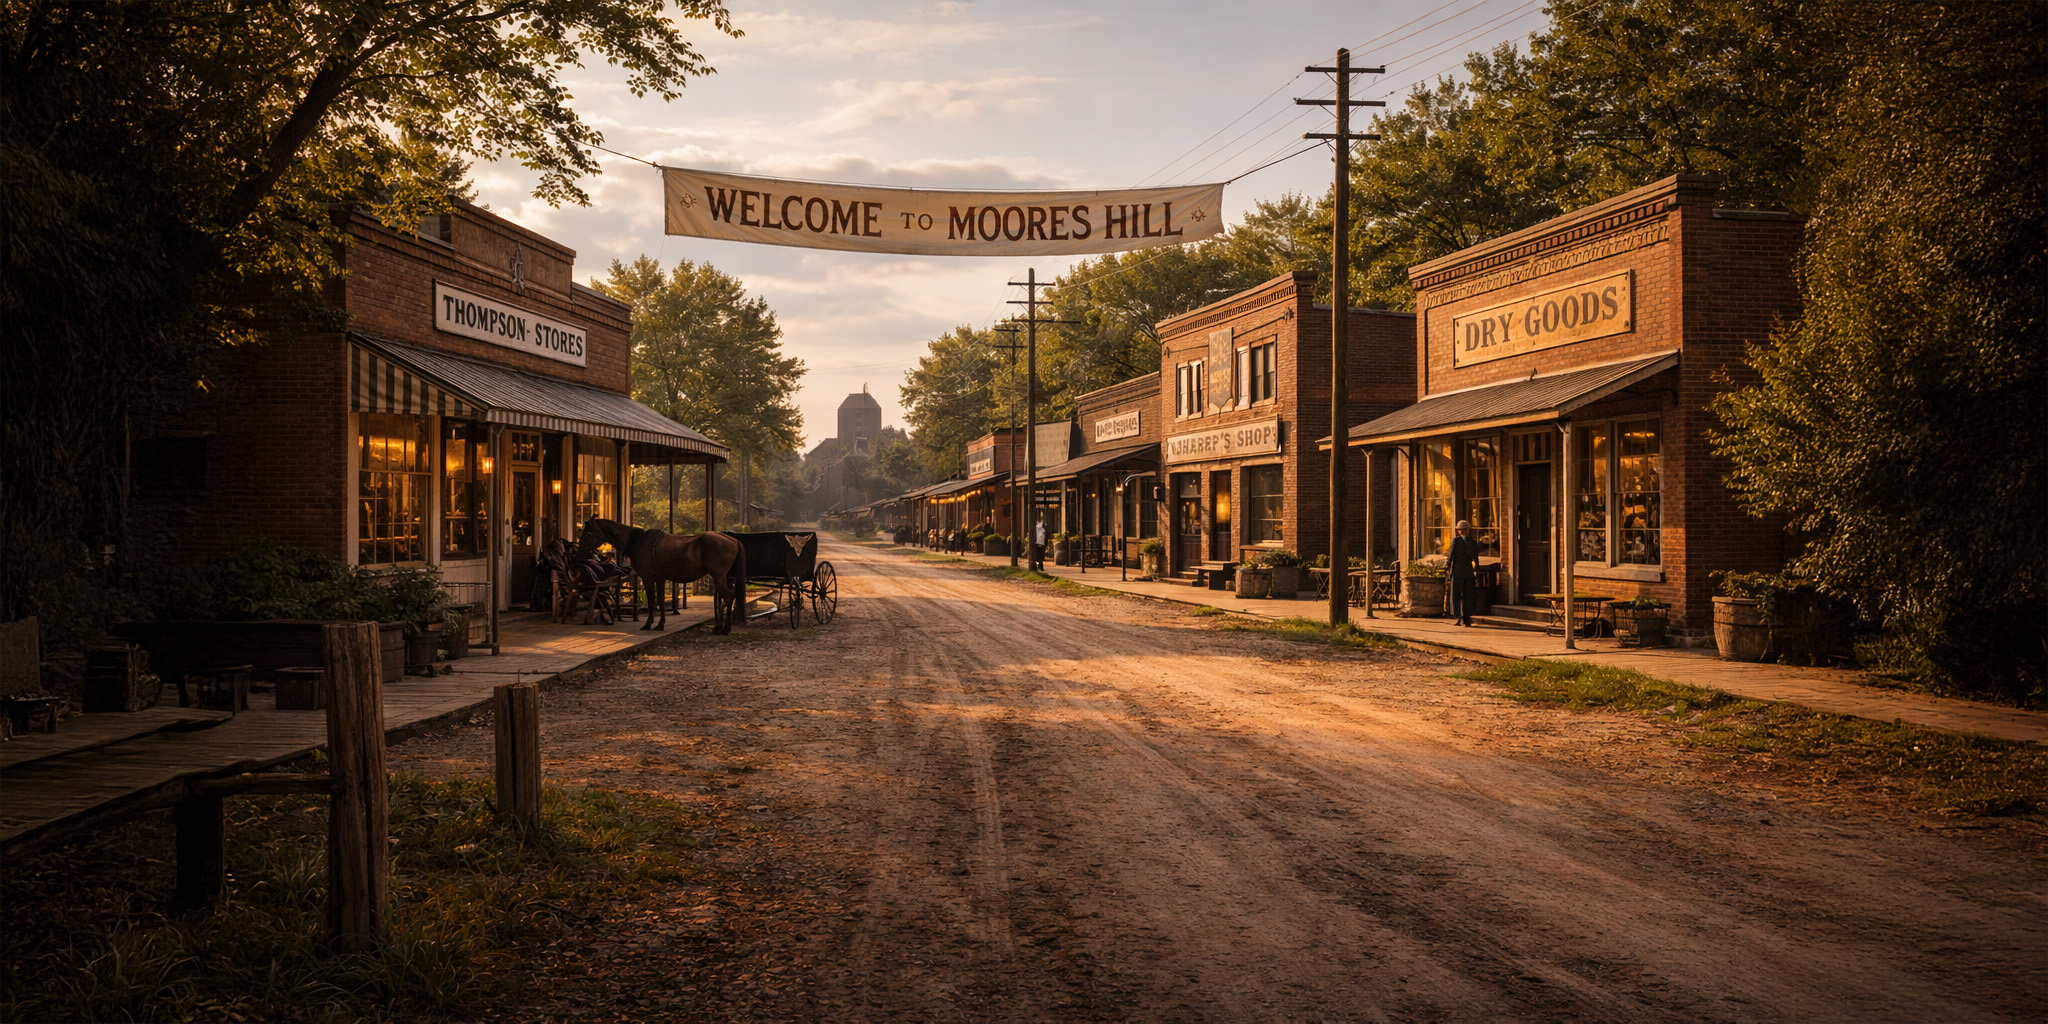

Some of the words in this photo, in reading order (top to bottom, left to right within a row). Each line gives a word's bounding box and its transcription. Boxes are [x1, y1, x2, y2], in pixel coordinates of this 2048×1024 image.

[704, 186, 883, 238] WELCOME
[900, 212, 934, 231] TO
[948, 205, 1092, 242] MOORES
[1104, 202, 1184, 240] HILL
[535, 322, 583, 357] STORES
[1465, 312, 1514, 351] DRY
[1524, 285, 1619, 337] GOODS
